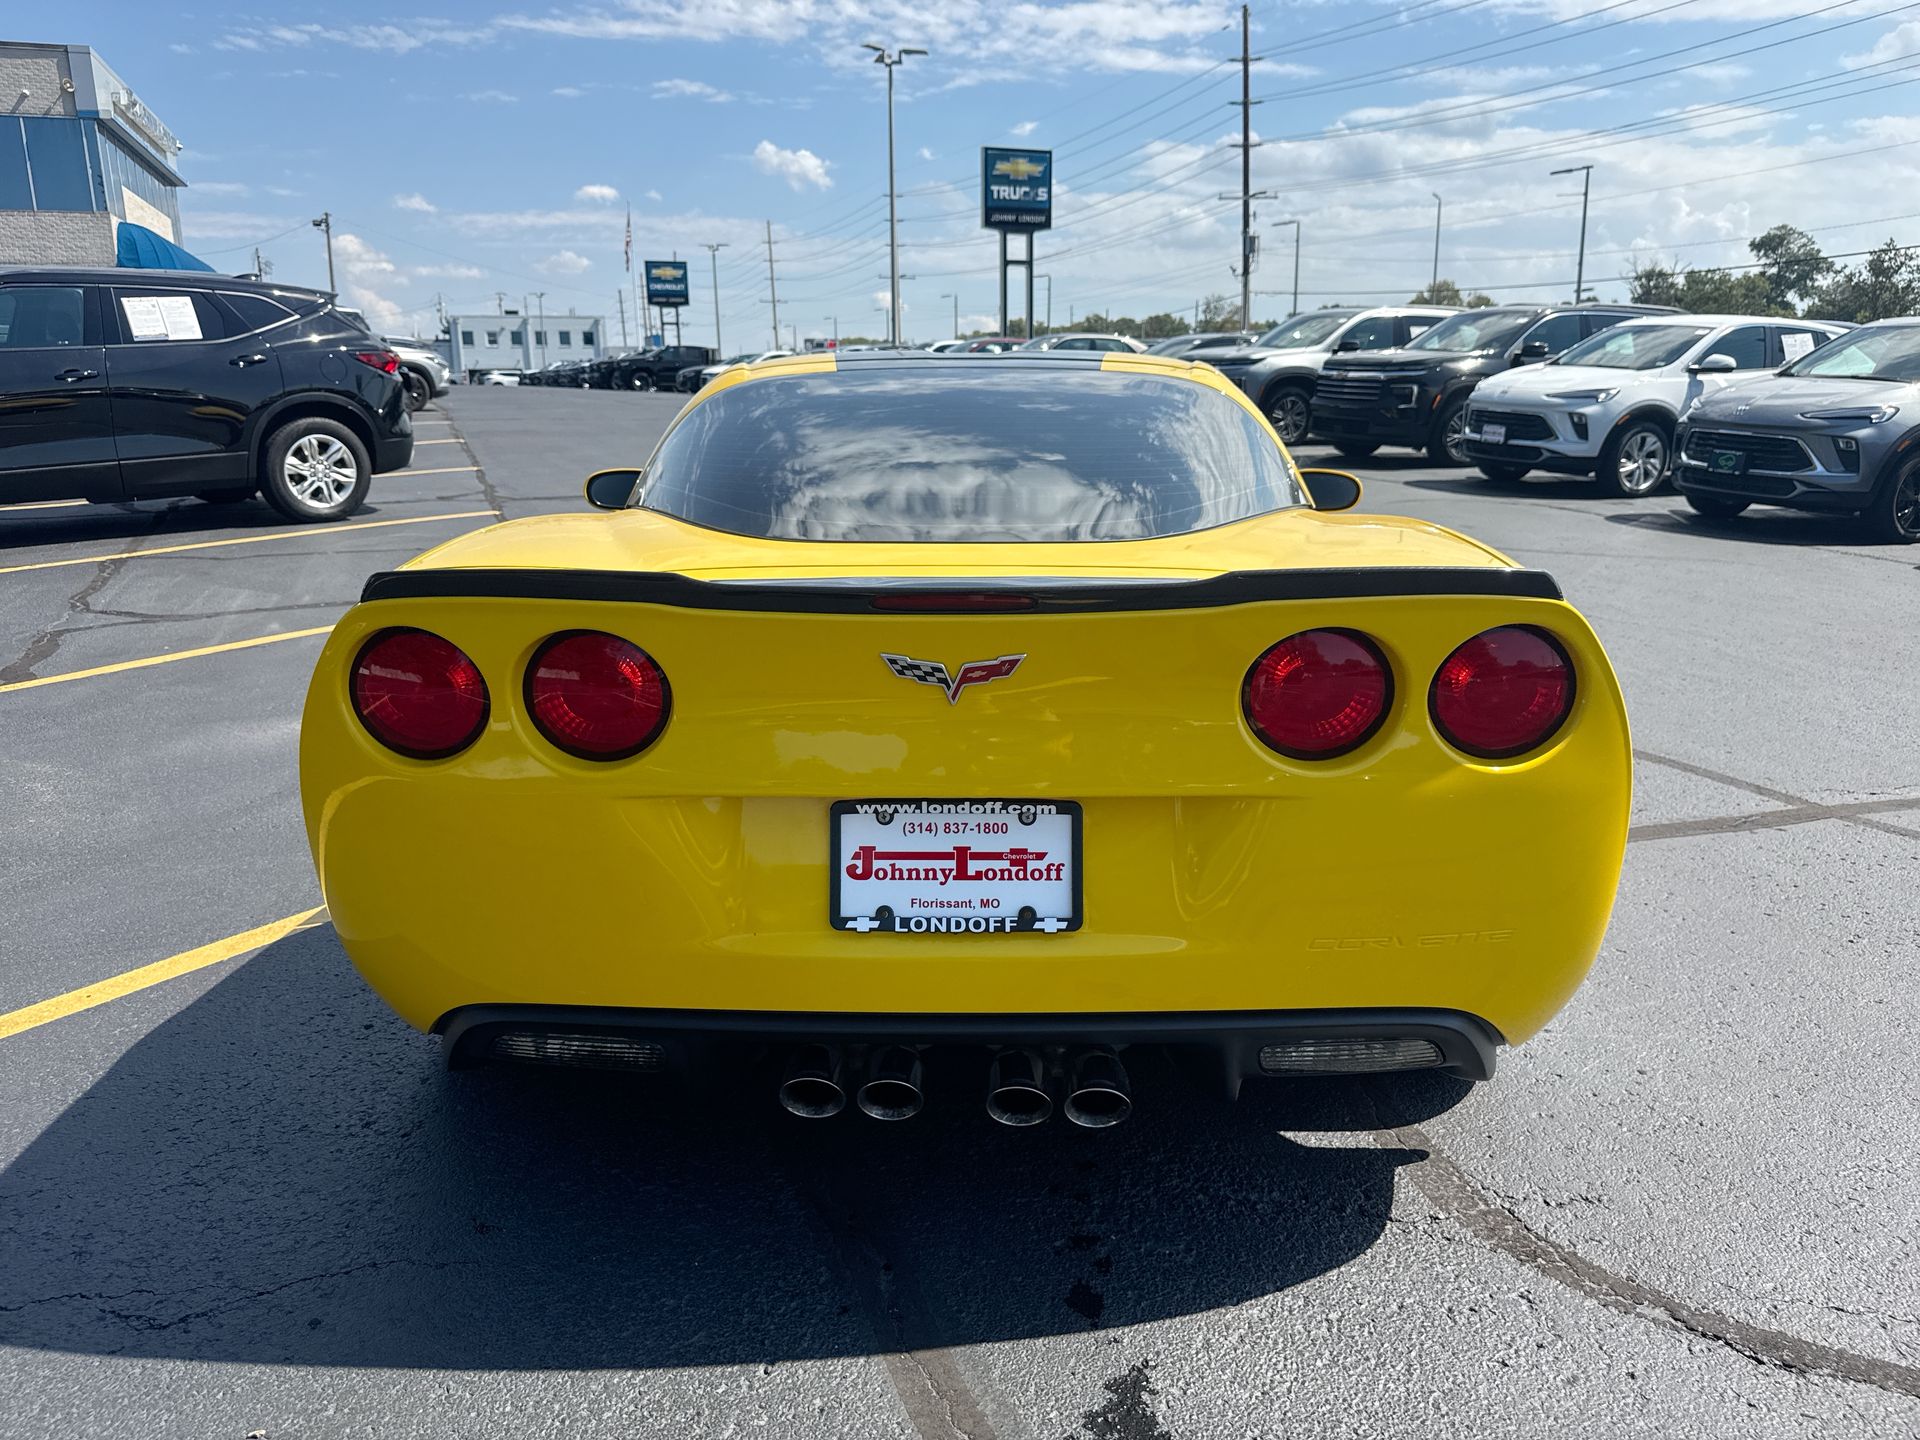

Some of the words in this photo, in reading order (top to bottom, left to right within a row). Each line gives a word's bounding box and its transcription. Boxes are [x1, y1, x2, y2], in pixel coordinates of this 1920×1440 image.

[990, 185, 1049, 201] TRUCS
[856, 801, 1057, 814] www.londoff.com
[902, 822, 939, 837] (314)
[943, 822, 1009, 835] 837-1800
[1002, 852, 1036, 860] Chevrolet
[846, 846, 954, 886] Johnny
[953, 846, 1065, 881] Londoff
[910, 898, 976, 910] Florissant,
[980, 899, 1001, 909] MO
[894, 917, 1019, 933] LONDOFF
[1306, 929, 1514, 952] CORVETTE
